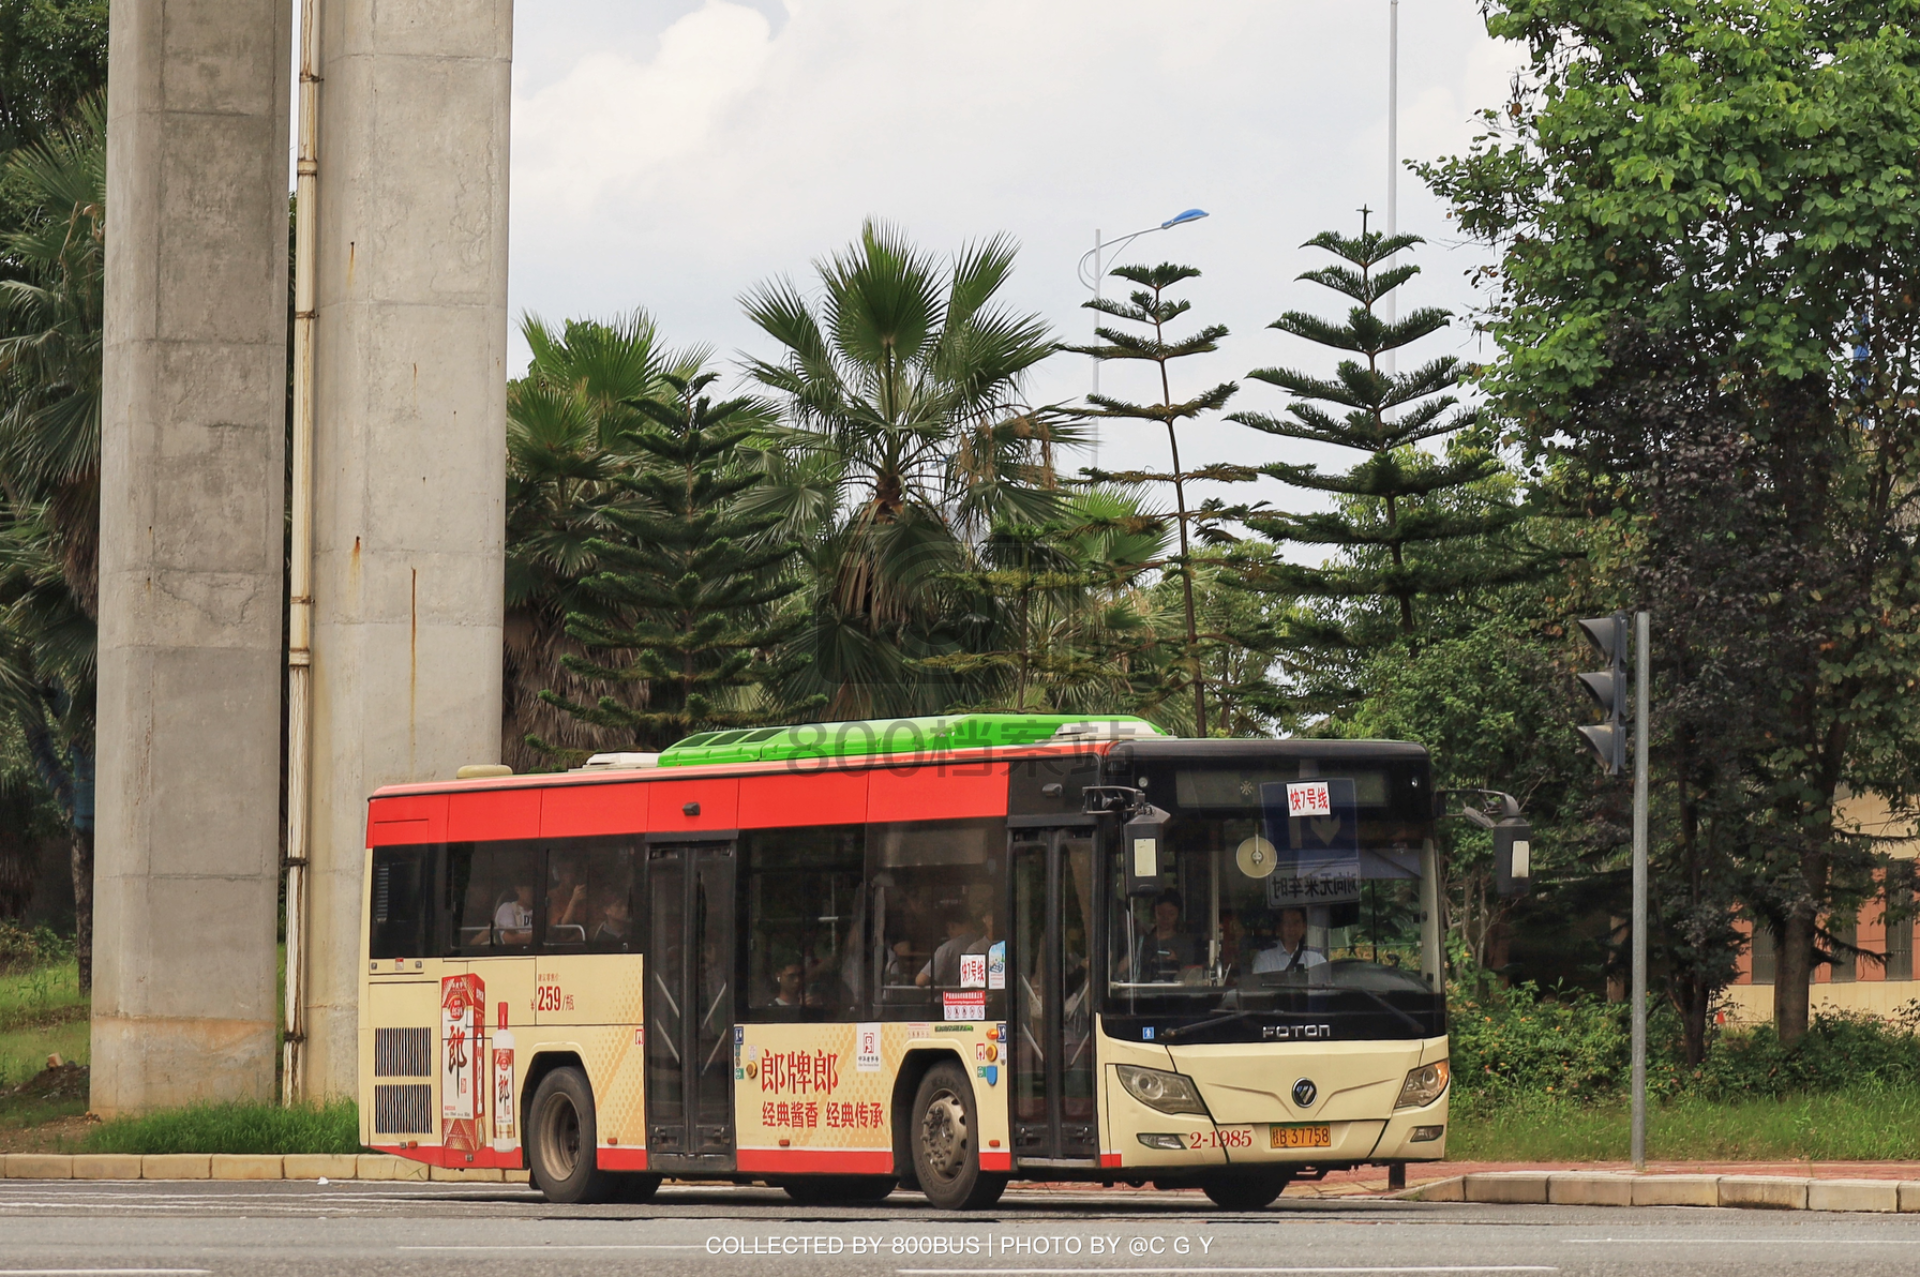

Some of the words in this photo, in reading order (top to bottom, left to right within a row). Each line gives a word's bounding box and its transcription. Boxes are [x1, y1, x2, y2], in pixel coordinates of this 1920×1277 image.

[1289, 786, 1328, 811] 快7号线
[1262, 1024, 1331, 1038] FOTON
[761, 1048, 839, 1095] 郎牌郎
[762, 1101, 819, 1129] 经典酱香
[826, 1101, 884, 1129] 经典传承
[1190, 1130, 1252, 1150] 2-1985
